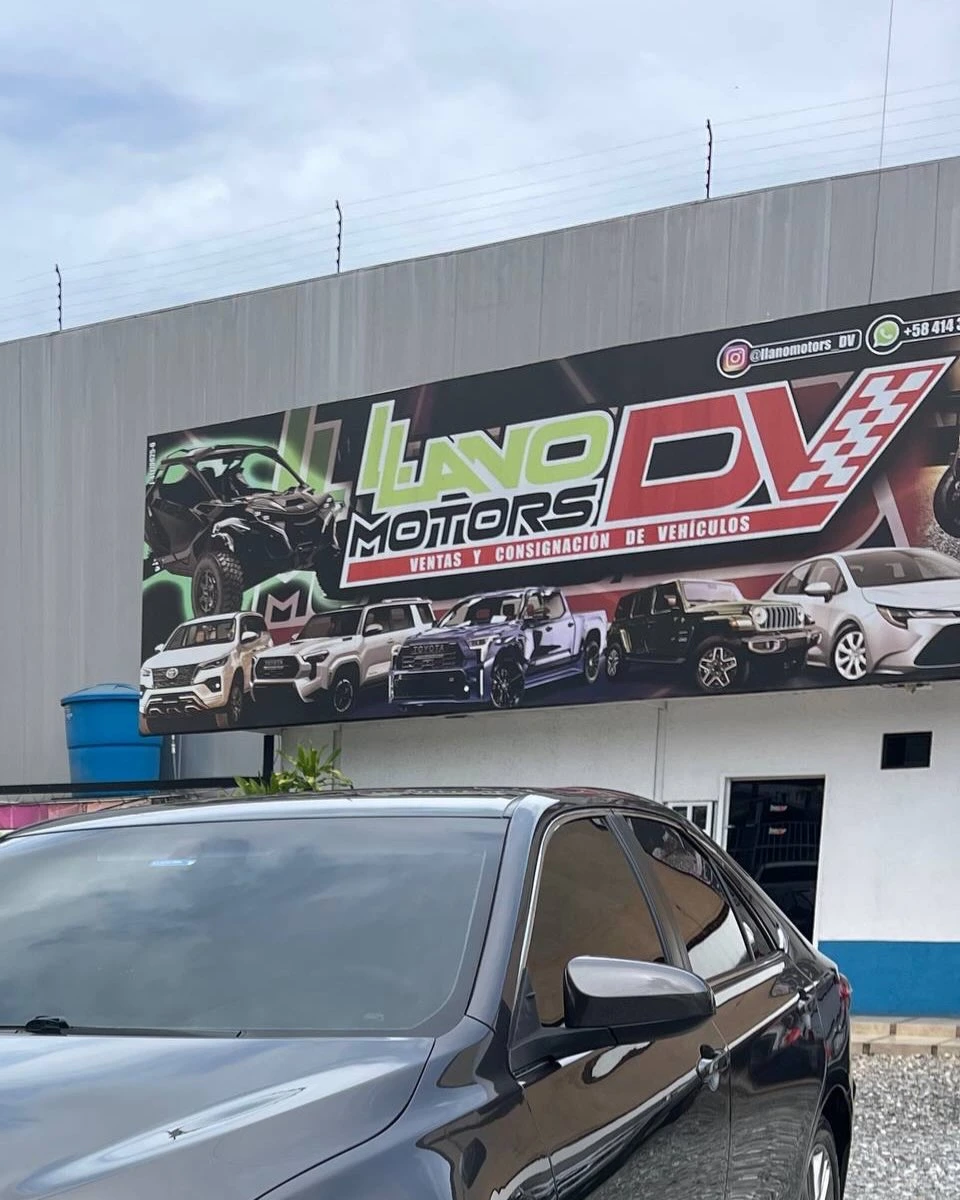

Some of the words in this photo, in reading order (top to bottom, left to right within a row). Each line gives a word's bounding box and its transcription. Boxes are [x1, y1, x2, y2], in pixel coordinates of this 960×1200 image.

[904, 322, 930, 338] +58
[931, 318, 954, 334] 414
[356, 400, 614, 514] LLANO
[604, 356, 956, 522] DV
[348, 483, 598, 558] MOTORS
[410, 552, 462, 572] VENTAS
[473, 550, 481, 565] Y
[495, 529, 610, 562] CONSIGNACIÓN
[625, 527, 645, 545] DE
[657, 515, 750, 542] VEHÍCULOS
